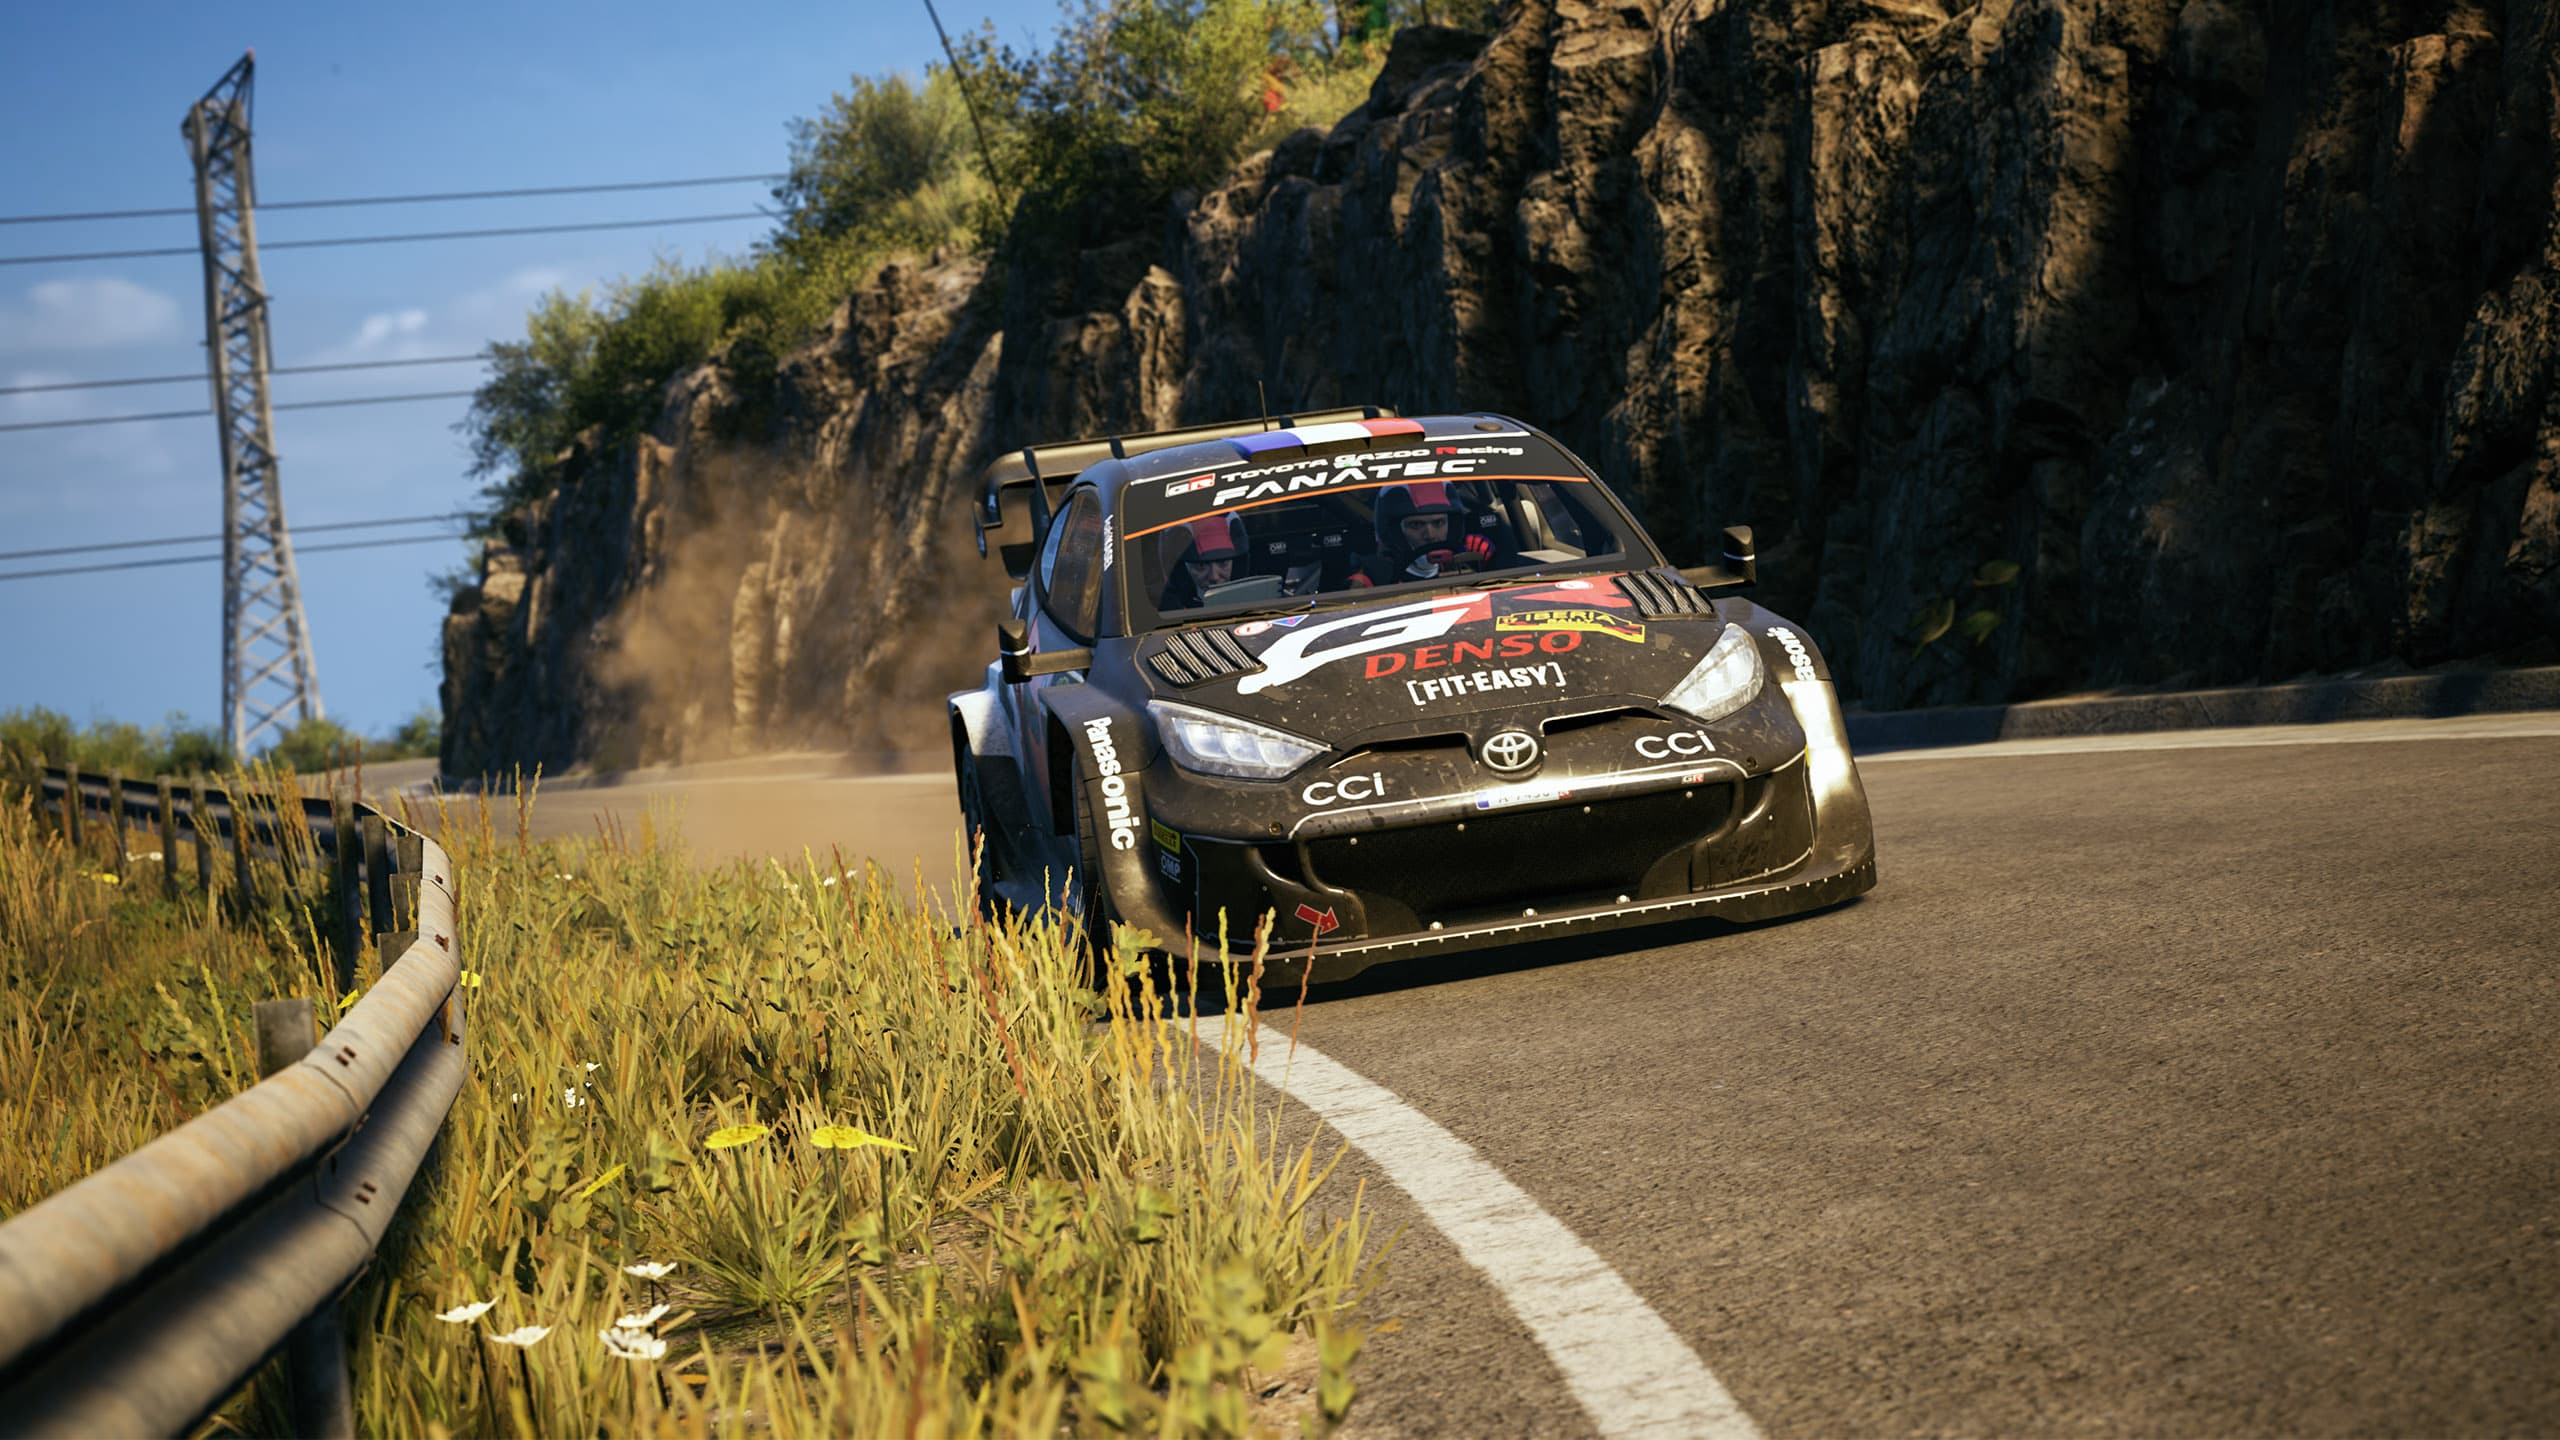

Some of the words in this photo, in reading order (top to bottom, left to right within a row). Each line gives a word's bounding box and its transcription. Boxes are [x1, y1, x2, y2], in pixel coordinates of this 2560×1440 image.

[1166, 473, 1215, 497] GR
[1221, 459, 1328, 482] TOYOTA
[1334, 448, 1430, 464] GAZOO
[1436, 446, 1524, 456] Racing
[1212, 459, 1478, 506] FANATEC
[1526, 611, 1616, 626] IBERIA
[1365, 631, 1582, 680] DENSO
[1766, 627, 1816, 680] asonic
[1083, 716, 1141, 850] Panasonic
[1682, 773, 1705, 784] GR
